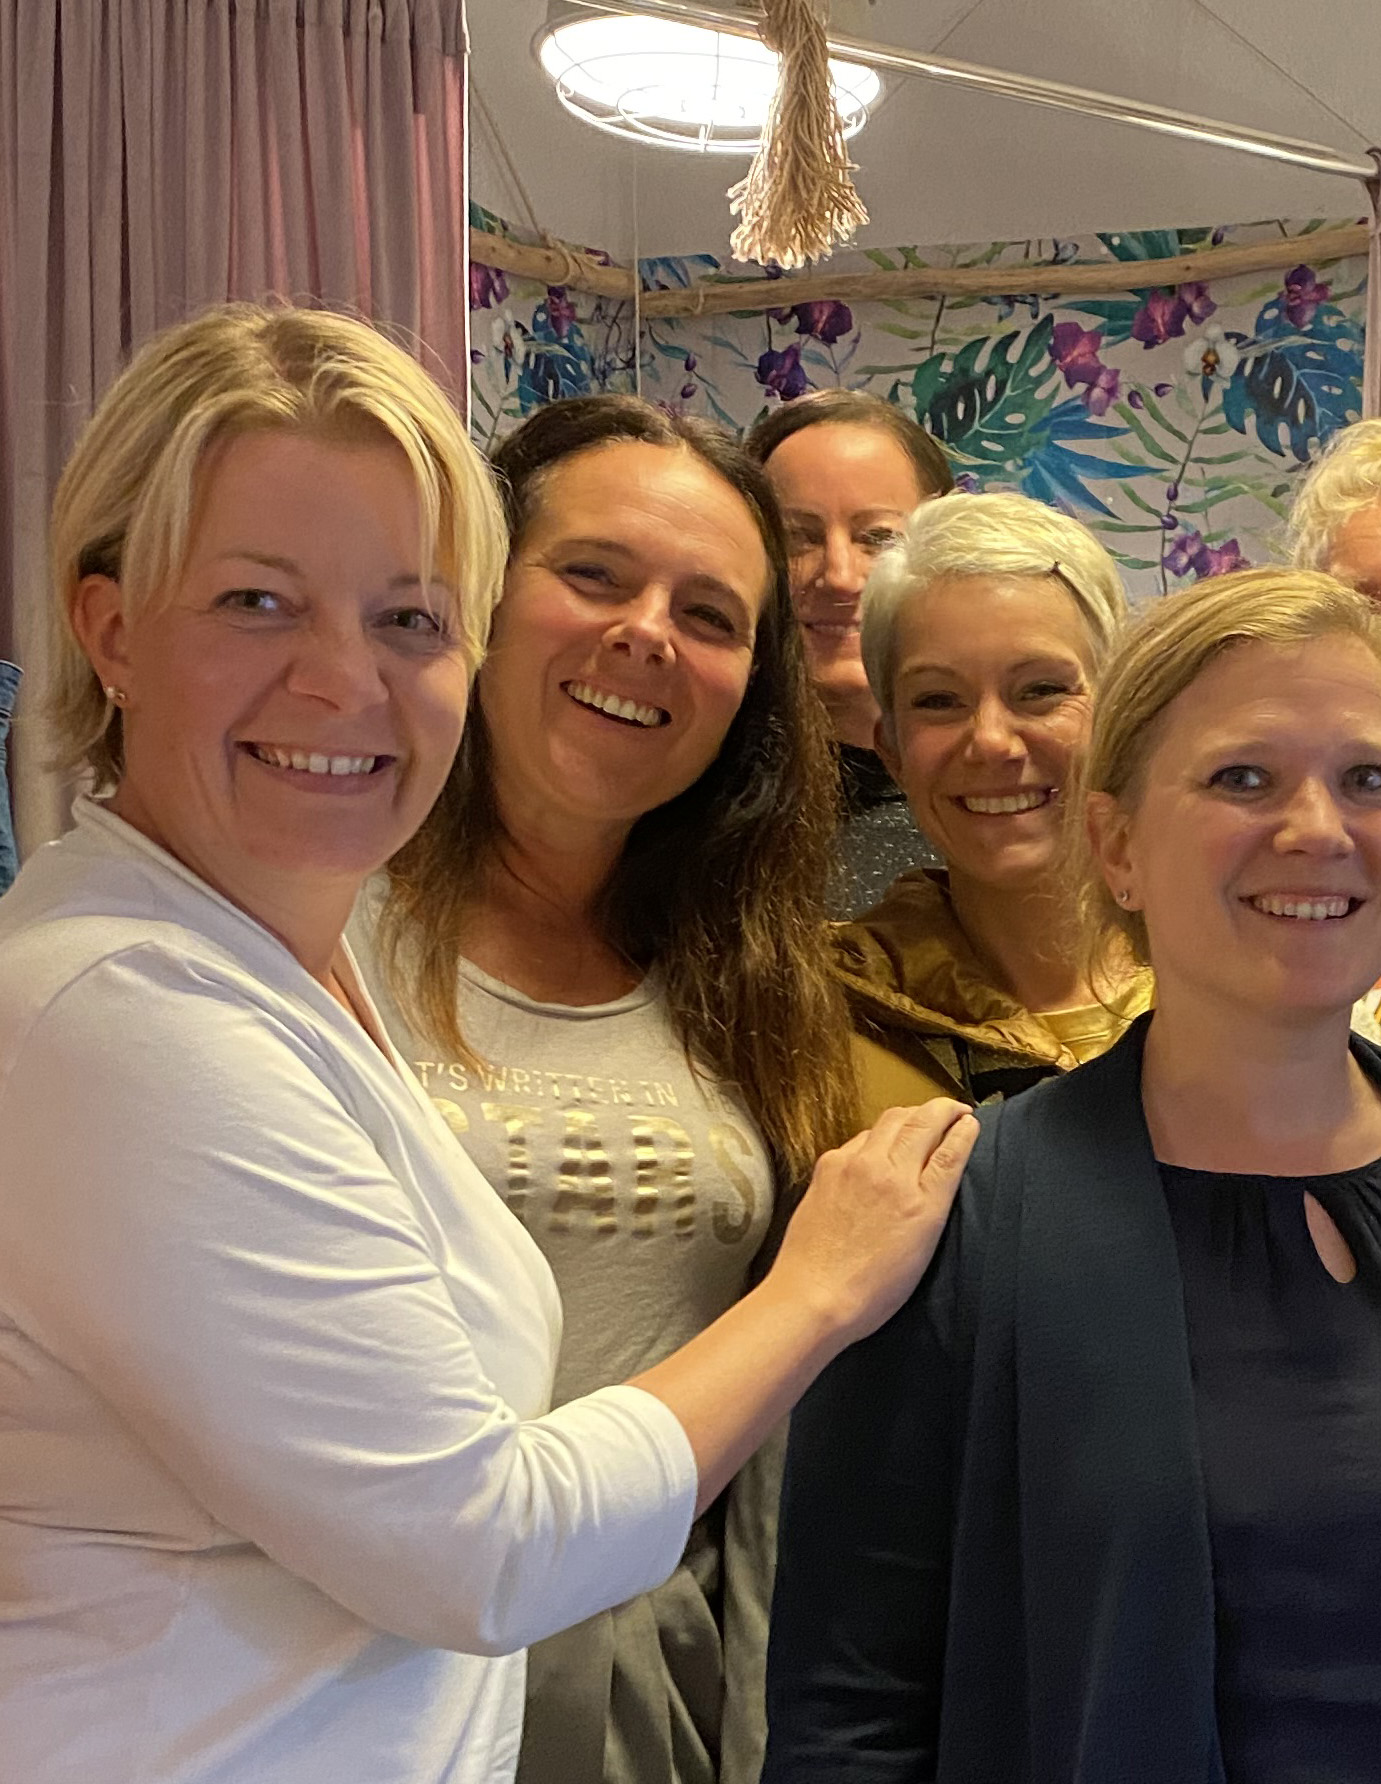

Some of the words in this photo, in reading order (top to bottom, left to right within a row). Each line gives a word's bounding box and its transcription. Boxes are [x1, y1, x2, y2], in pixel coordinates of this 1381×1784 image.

[413, 1060, 469, 1092] T'S
[477, 1064, 630, 1107] WRITTEN
[639, 1080, 680, 1107] IN
